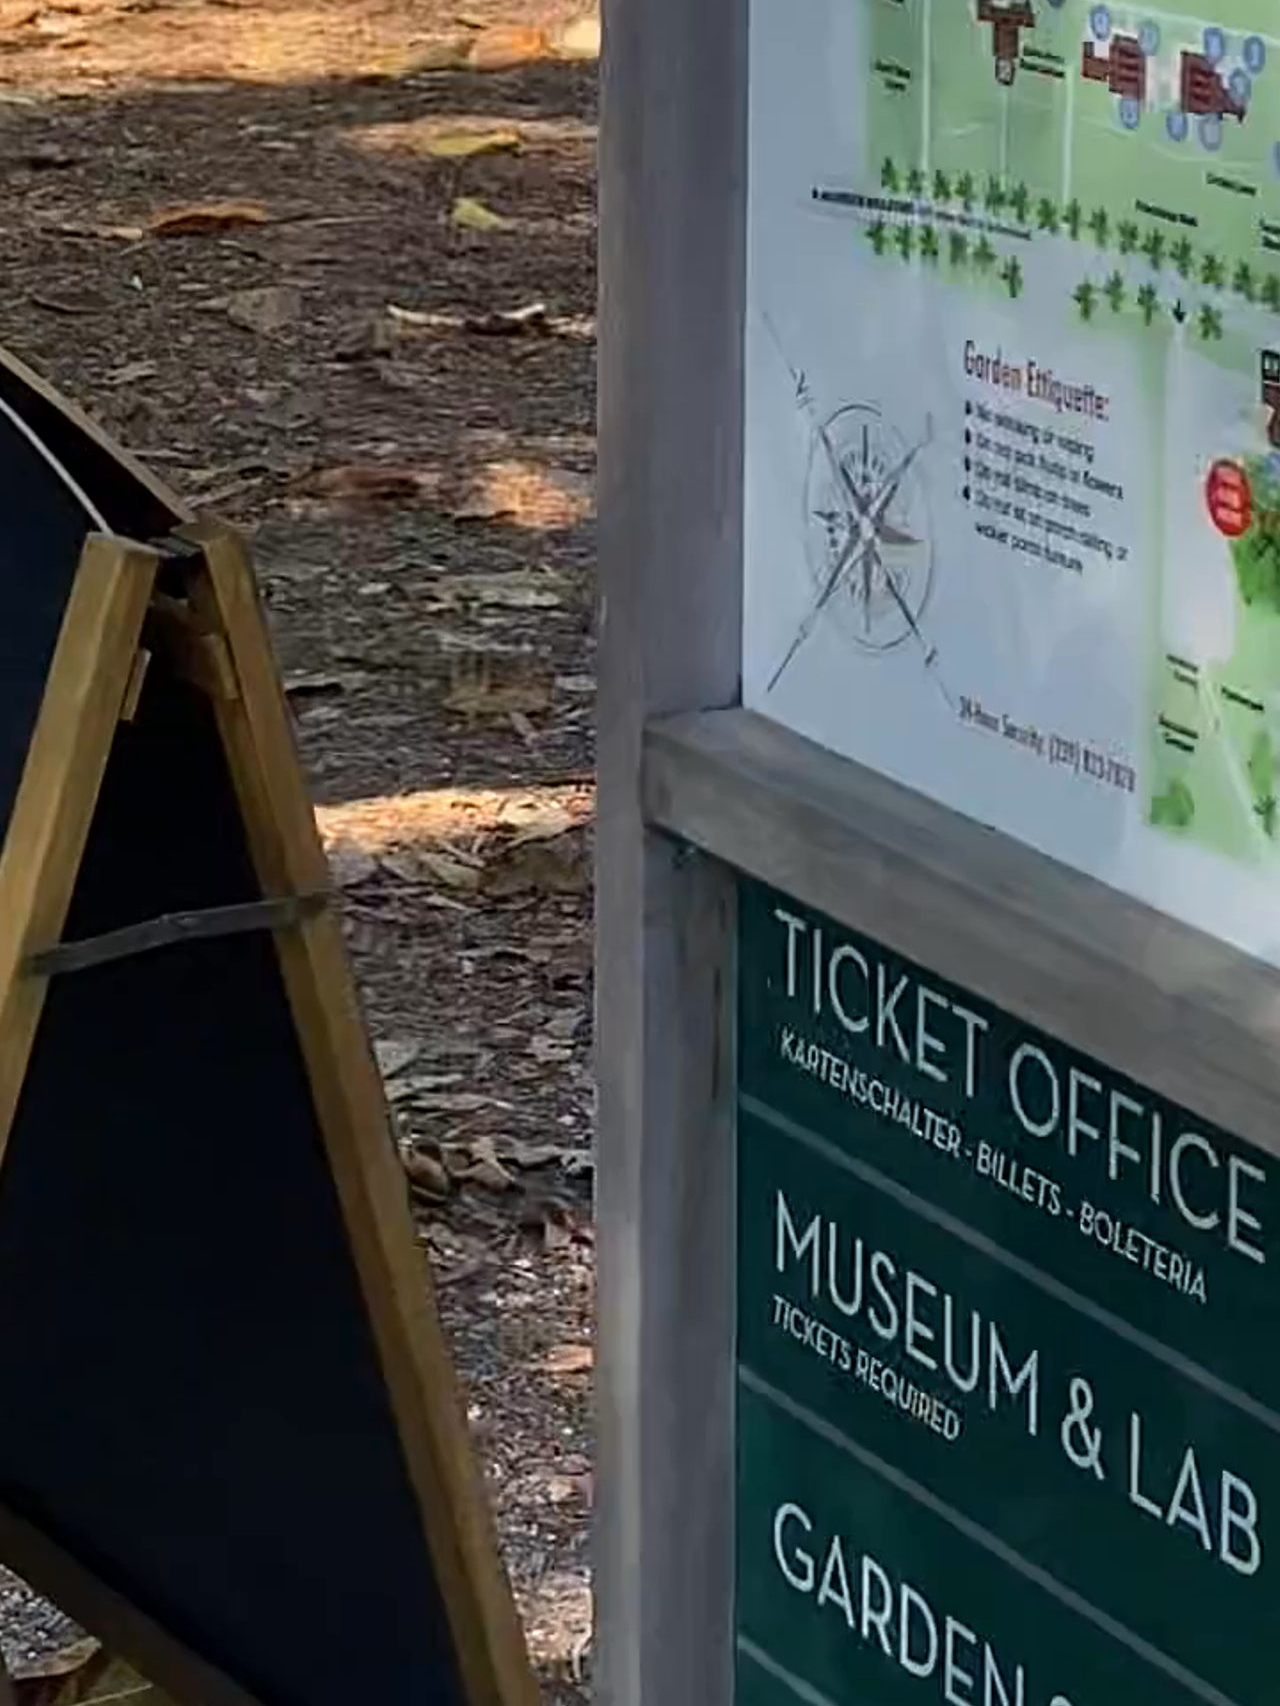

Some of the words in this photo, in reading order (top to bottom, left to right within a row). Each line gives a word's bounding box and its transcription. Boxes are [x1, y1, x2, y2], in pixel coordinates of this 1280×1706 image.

[964, 340, 1022, 391] Garden
[775, 907, 989, 1098] TICKET
[1008, 1041, 1268, 1265] OFFICE
[779, 1026, 963, 1160] KARTENSCHALTER
[976, 1139, 1062, 1217] BILLETS
[1078, 1199, 1209, 1305] BOLETERIA
[771, 1292, 852, 1371] TICKETS
[854, 1346, 962, 1443] REQUIRED
[773, 1188, 1040, 1437] MUSEUM
[1059, 1376, 1108, 1481] &
[1128, 1409, 1265, 1577] LAB
